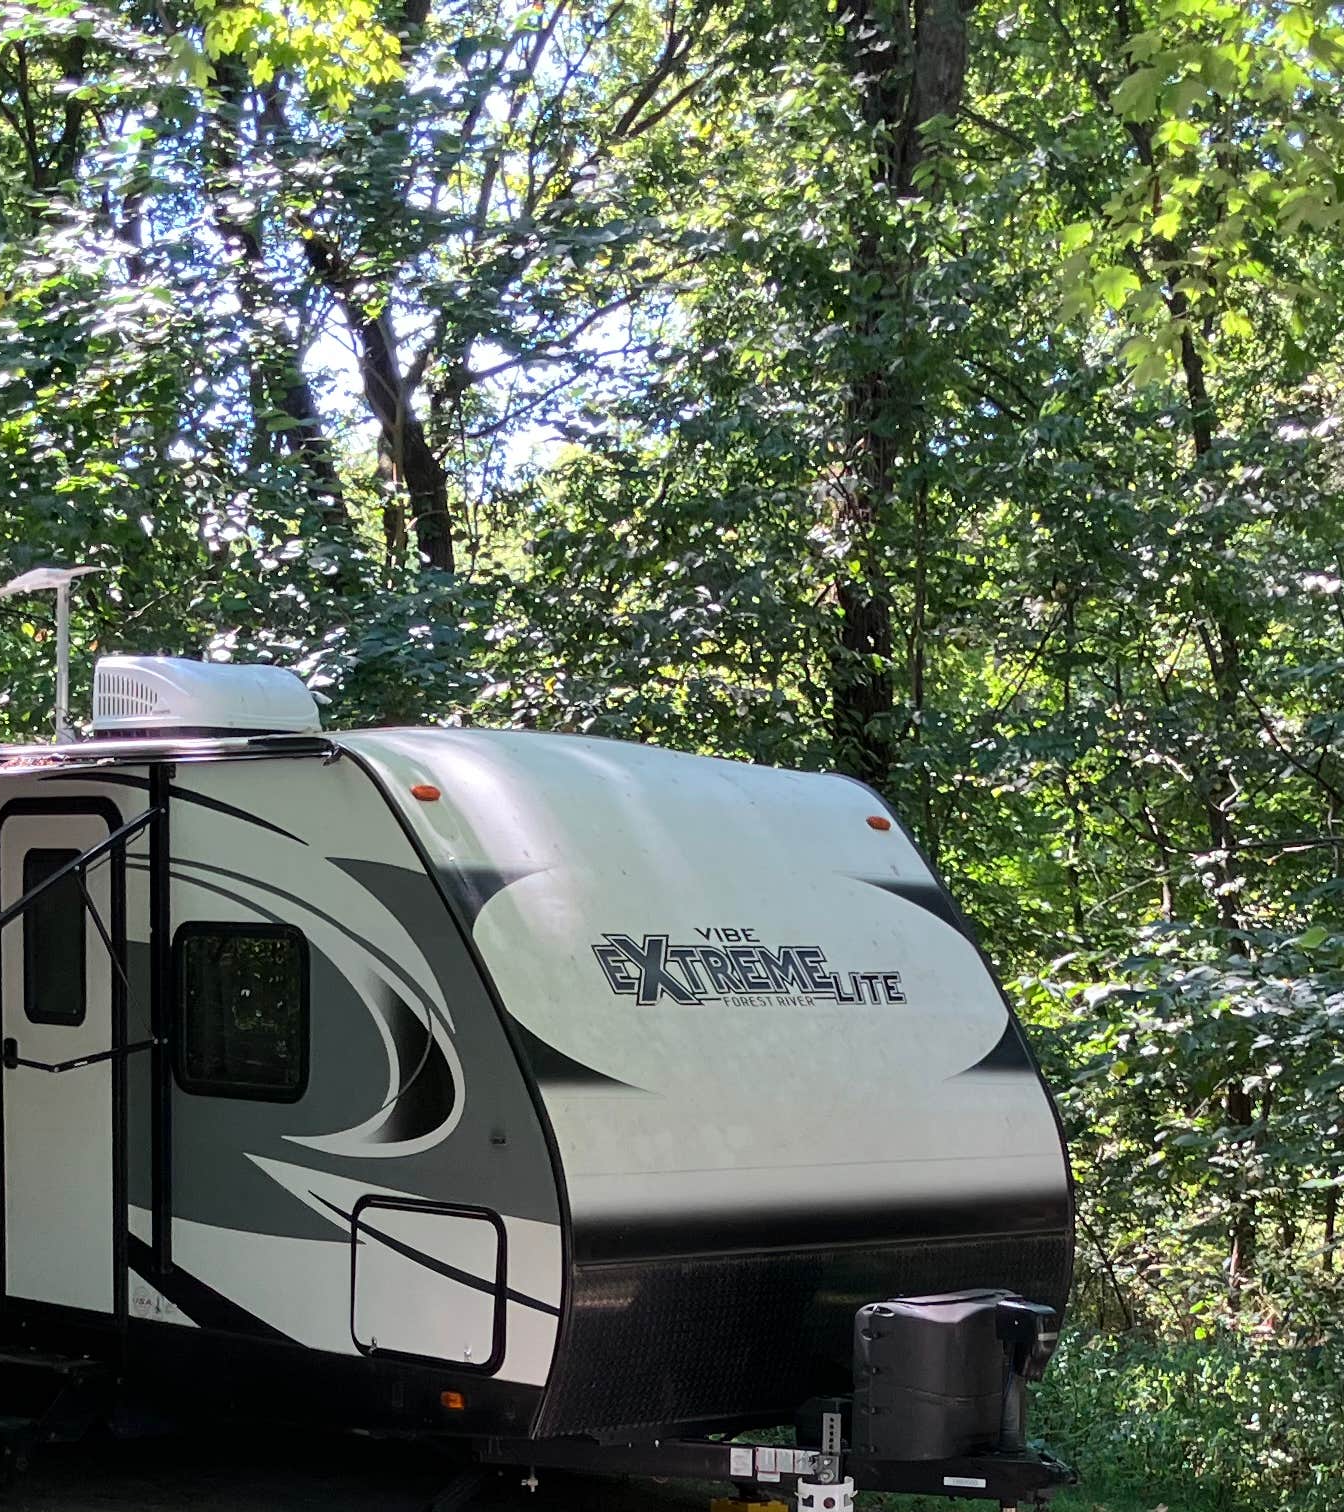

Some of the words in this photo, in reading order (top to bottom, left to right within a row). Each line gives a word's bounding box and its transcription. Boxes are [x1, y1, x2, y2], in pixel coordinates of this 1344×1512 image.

[694, 927, 760, 942] VIBE
[591, 933, 833, 1006] EXTREME
[829, 971, 907, 1004] LITE
[723, 996, 773, 1007] FOREST
[777, 996, 816, 1007] RIVER
